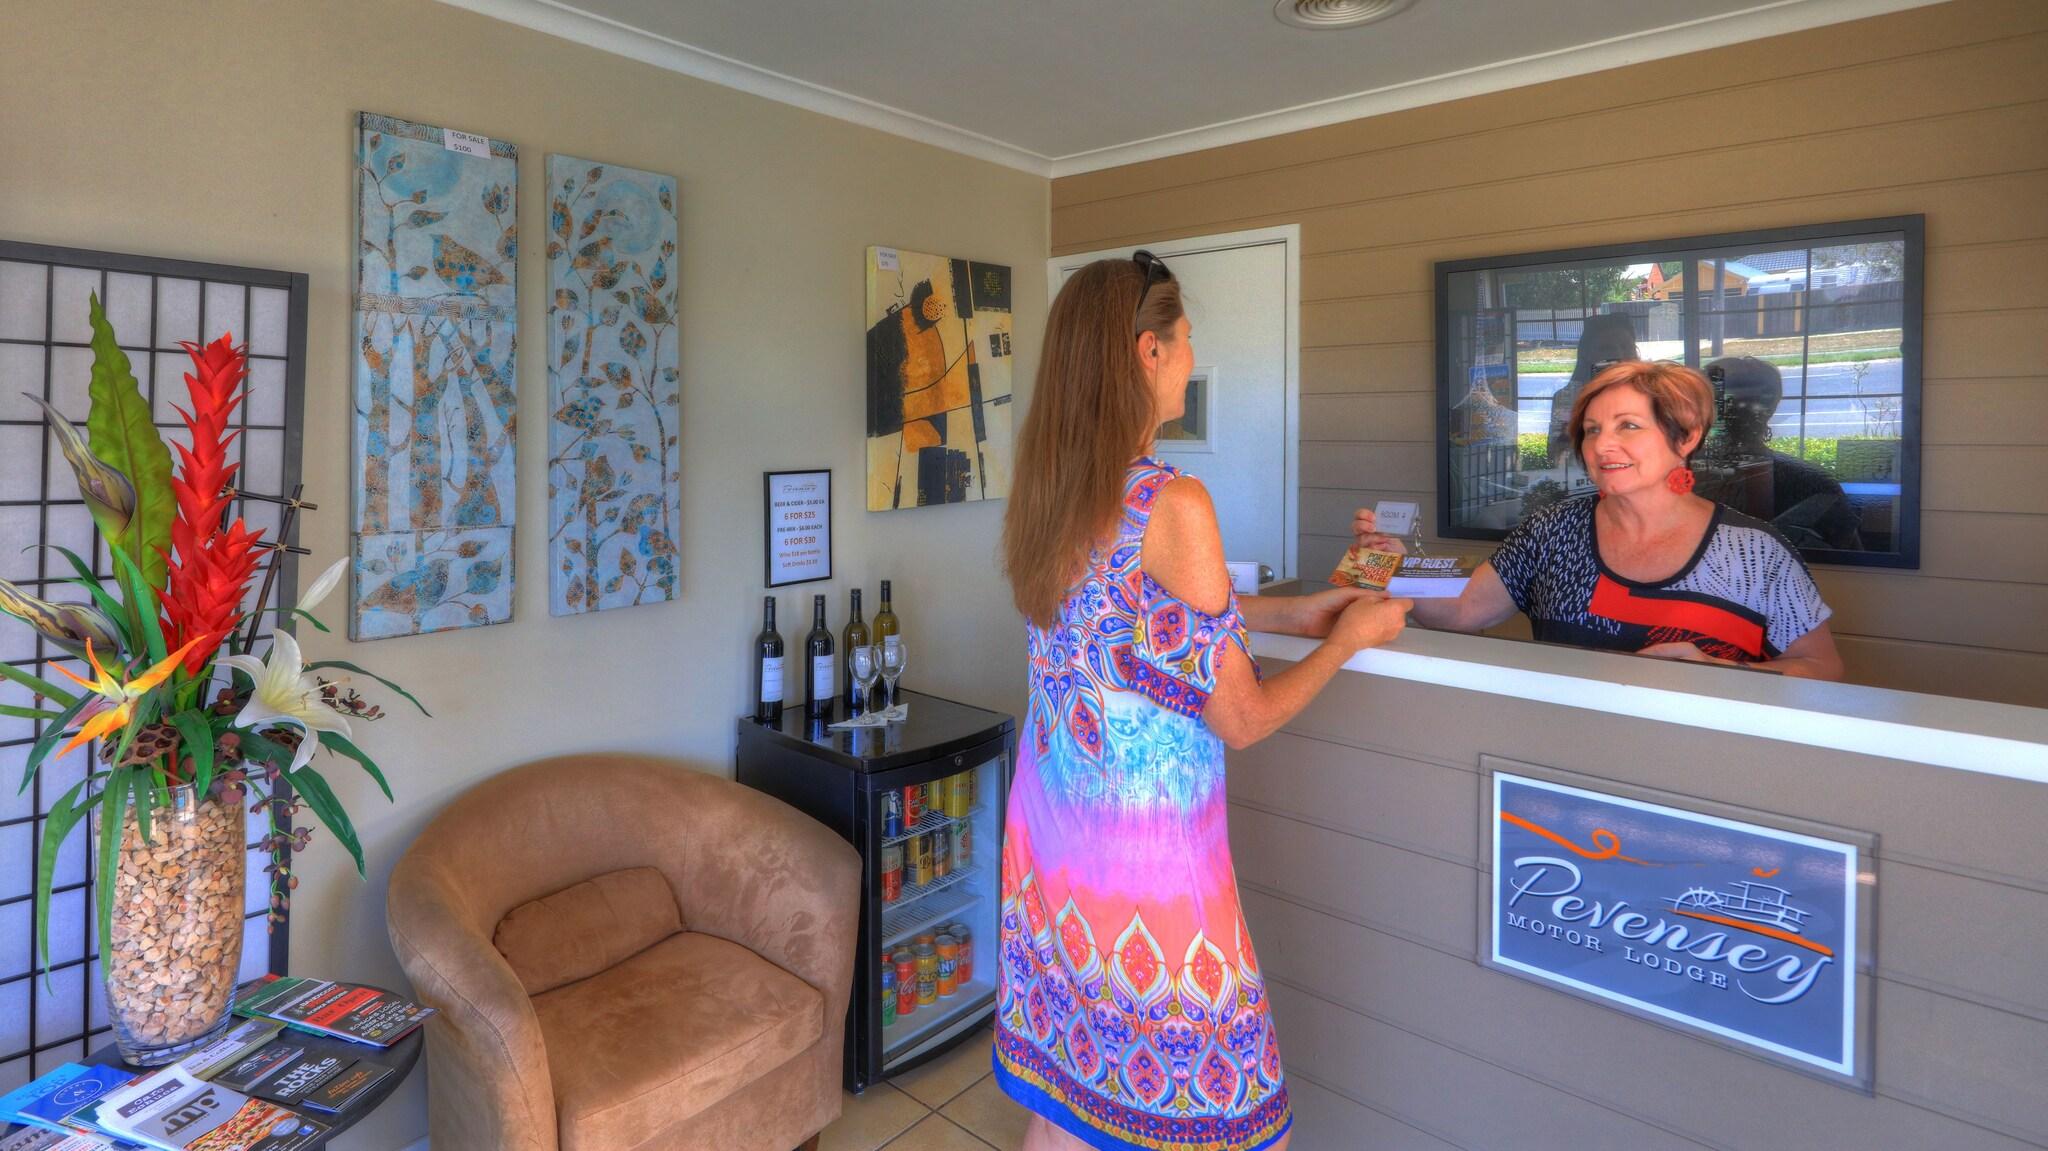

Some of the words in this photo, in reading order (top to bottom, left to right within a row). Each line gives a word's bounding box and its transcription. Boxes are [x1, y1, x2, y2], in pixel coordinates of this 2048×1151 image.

[452, 131, 467, 142] FOR
[468, 133, 485, 145] SALE
[453, 143, 472, 153] $100
[784, 512, 789, 520] 6
[790, 511, 803, 520] FOR
[804, 511, 816, 519] $25
[784, 538, 789, 546] 6
[790, 537, 803, 545] FOR
[804, 536, 816, 544] $30
[1402, 556, 1420, 568] VIP
[1421, 558, 1458, 569] GUEST
[1509, 856, 1835, 1005] Pevensey
[1507, 912, 1603, 953] MOTOR
[1624, 945, 1729, 990] LODGE
[273, 1061, 317, 1087] THE
[275, 1056, 338, 1098] ROCKS
